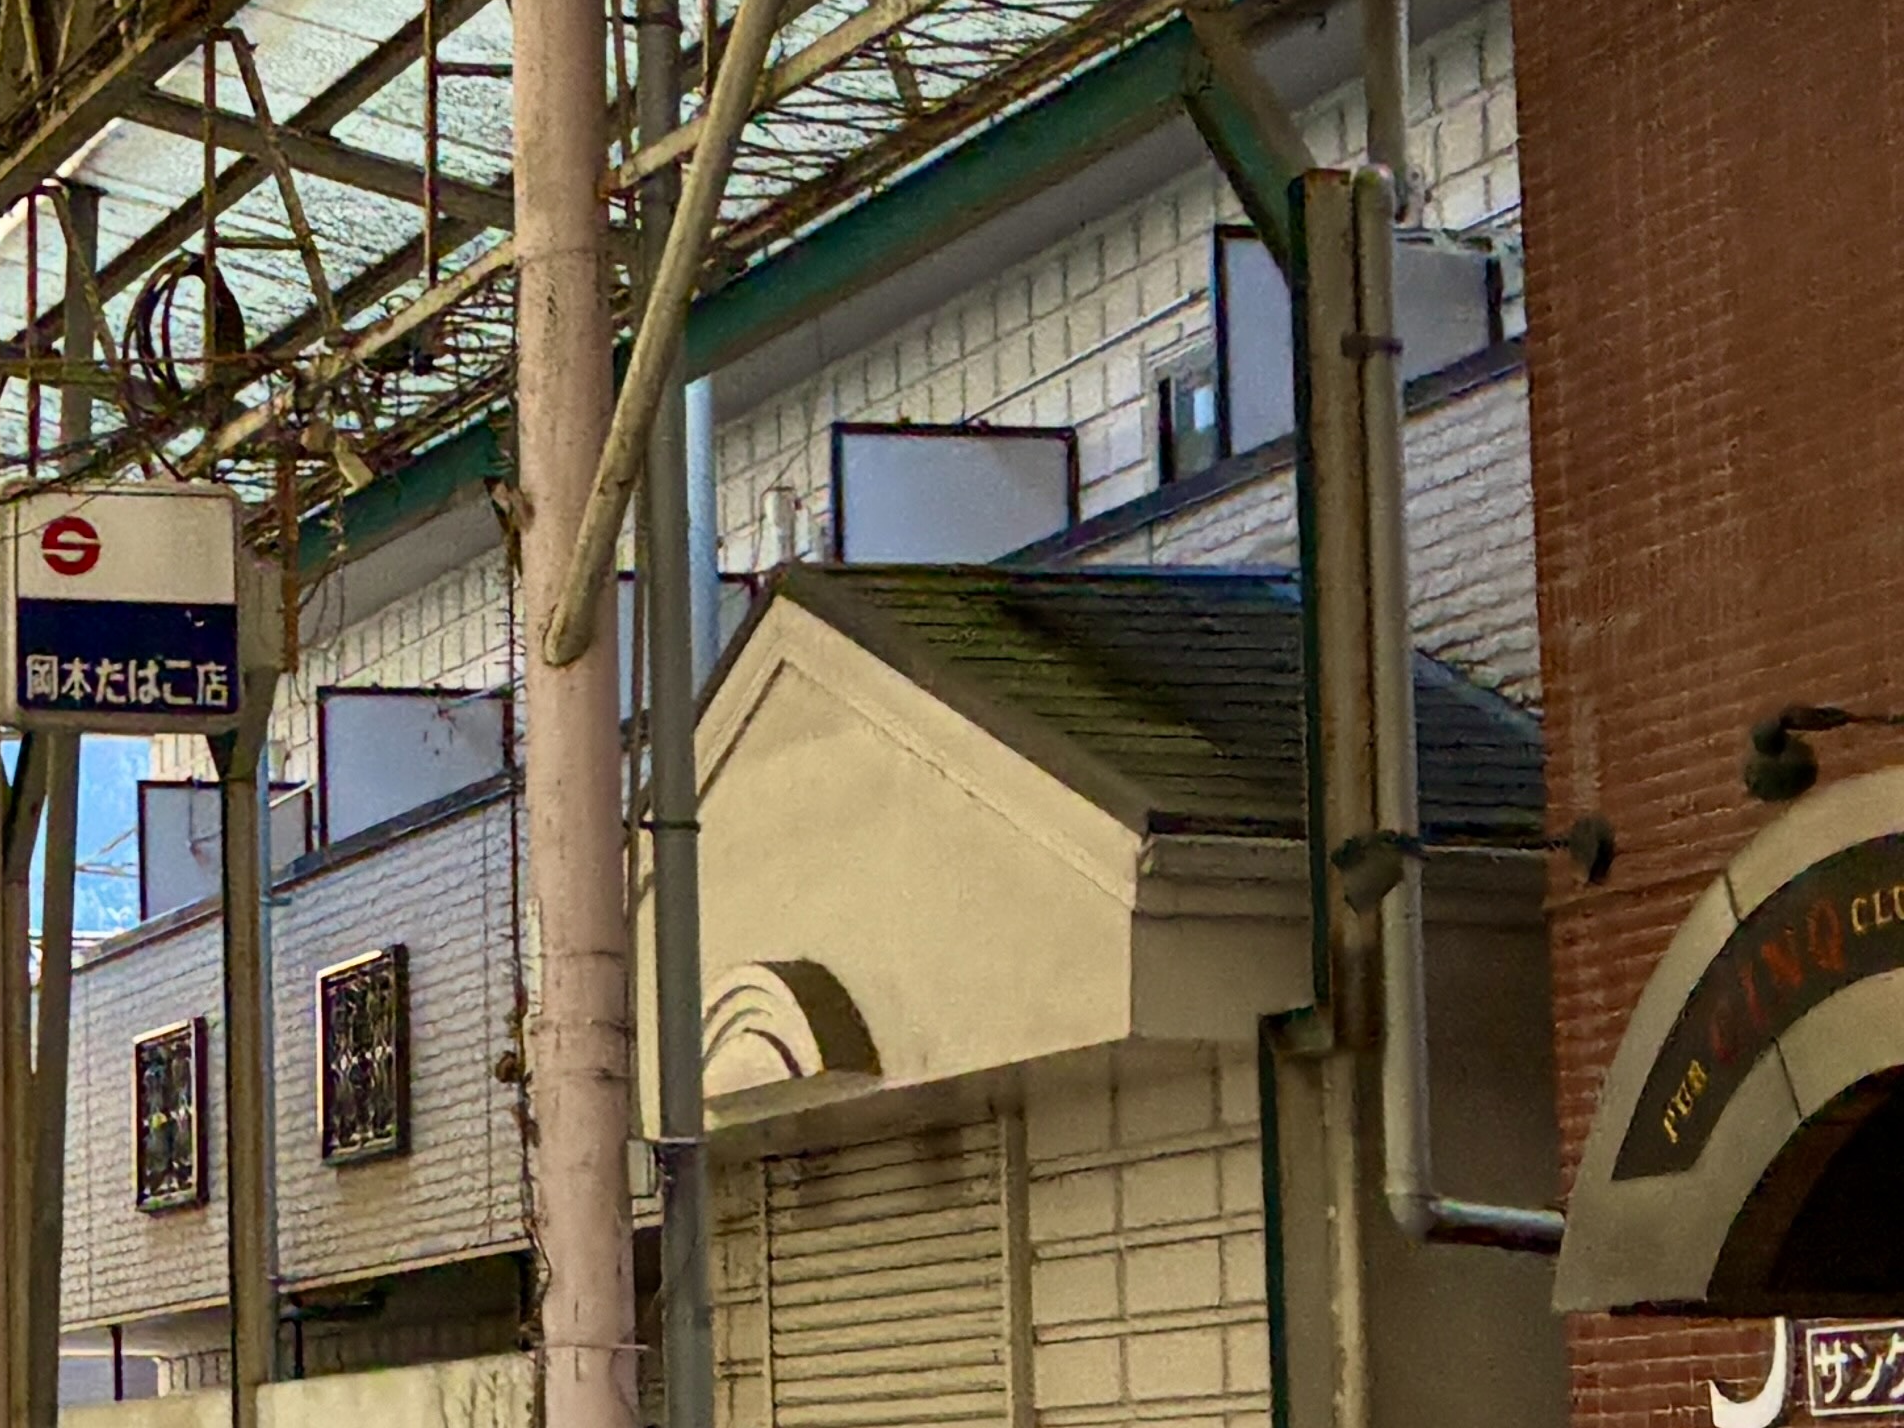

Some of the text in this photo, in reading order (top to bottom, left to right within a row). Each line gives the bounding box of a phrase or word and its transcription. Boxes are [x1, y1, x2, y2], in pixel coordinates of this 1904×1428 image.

[26, 654, 229, 706] 岡本たばこ店
